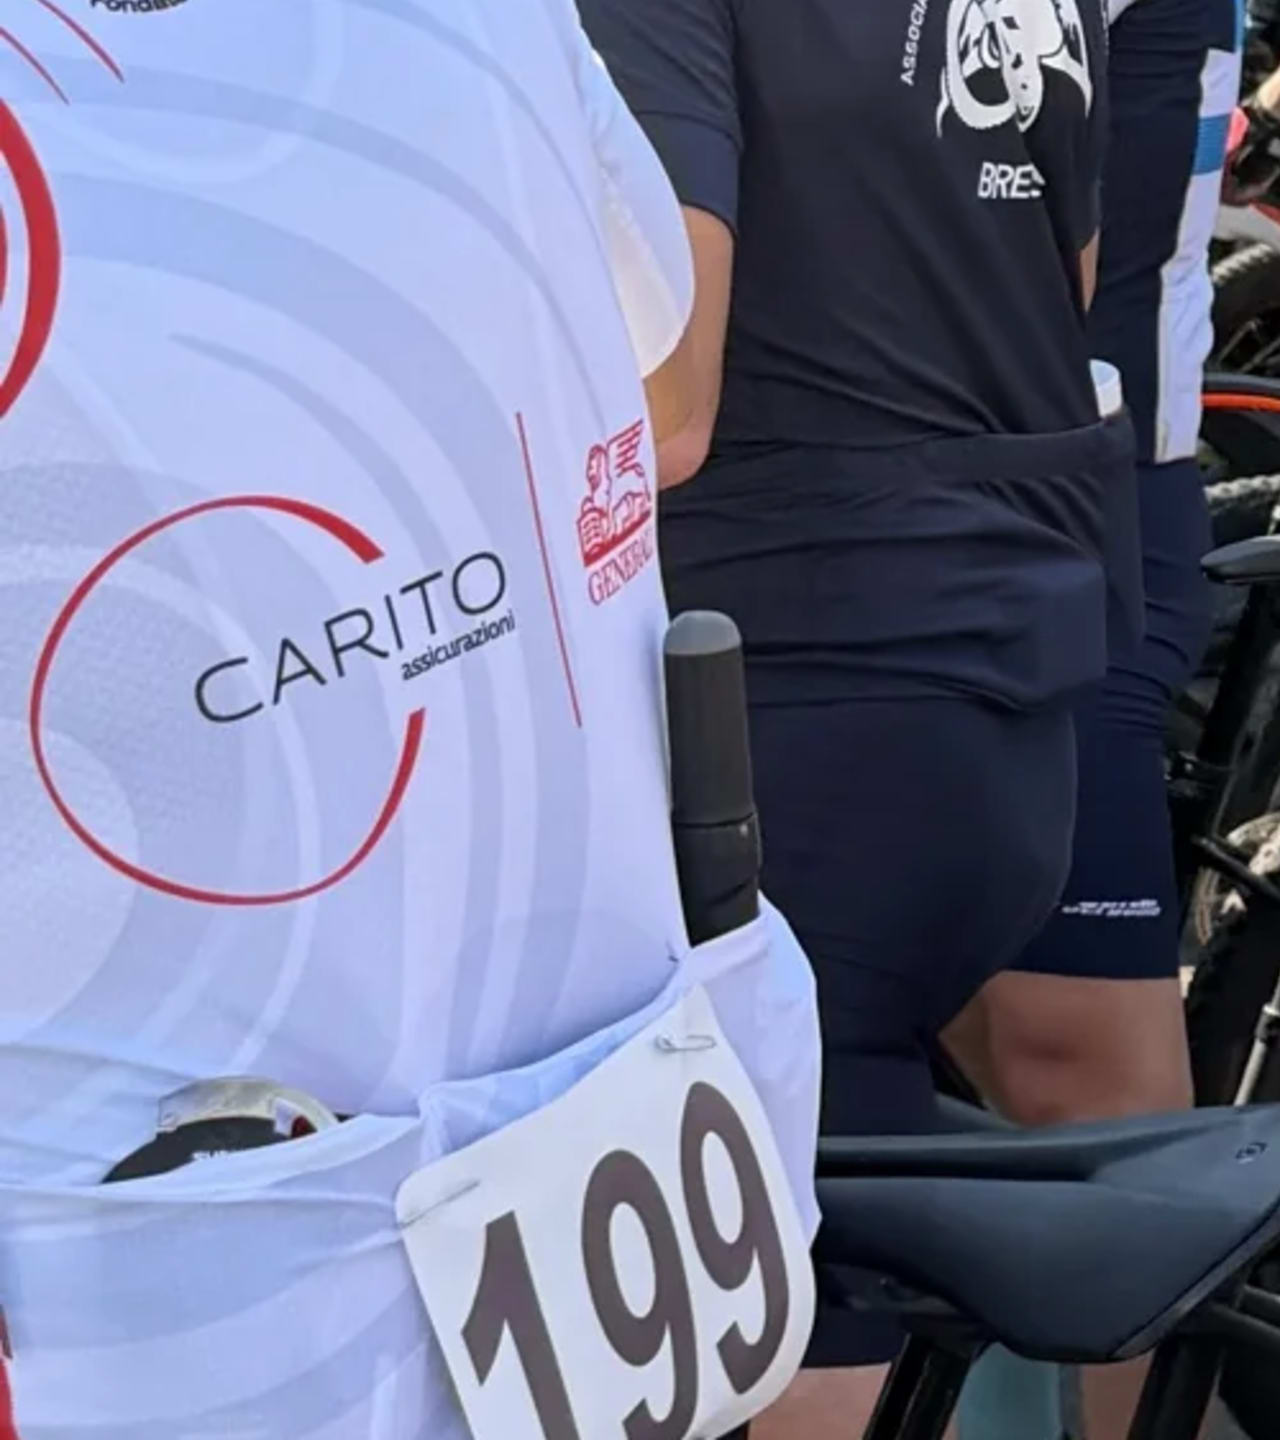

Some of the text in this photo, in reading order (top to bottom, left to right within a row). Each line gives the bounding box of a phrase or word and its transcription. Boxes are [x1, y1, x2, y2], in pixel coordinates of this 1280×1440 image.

[194, 551, 505, 722] CARITO
[402, 609, 516, 681] assicurazioni
[461, 1081, 791, 1440] 199
